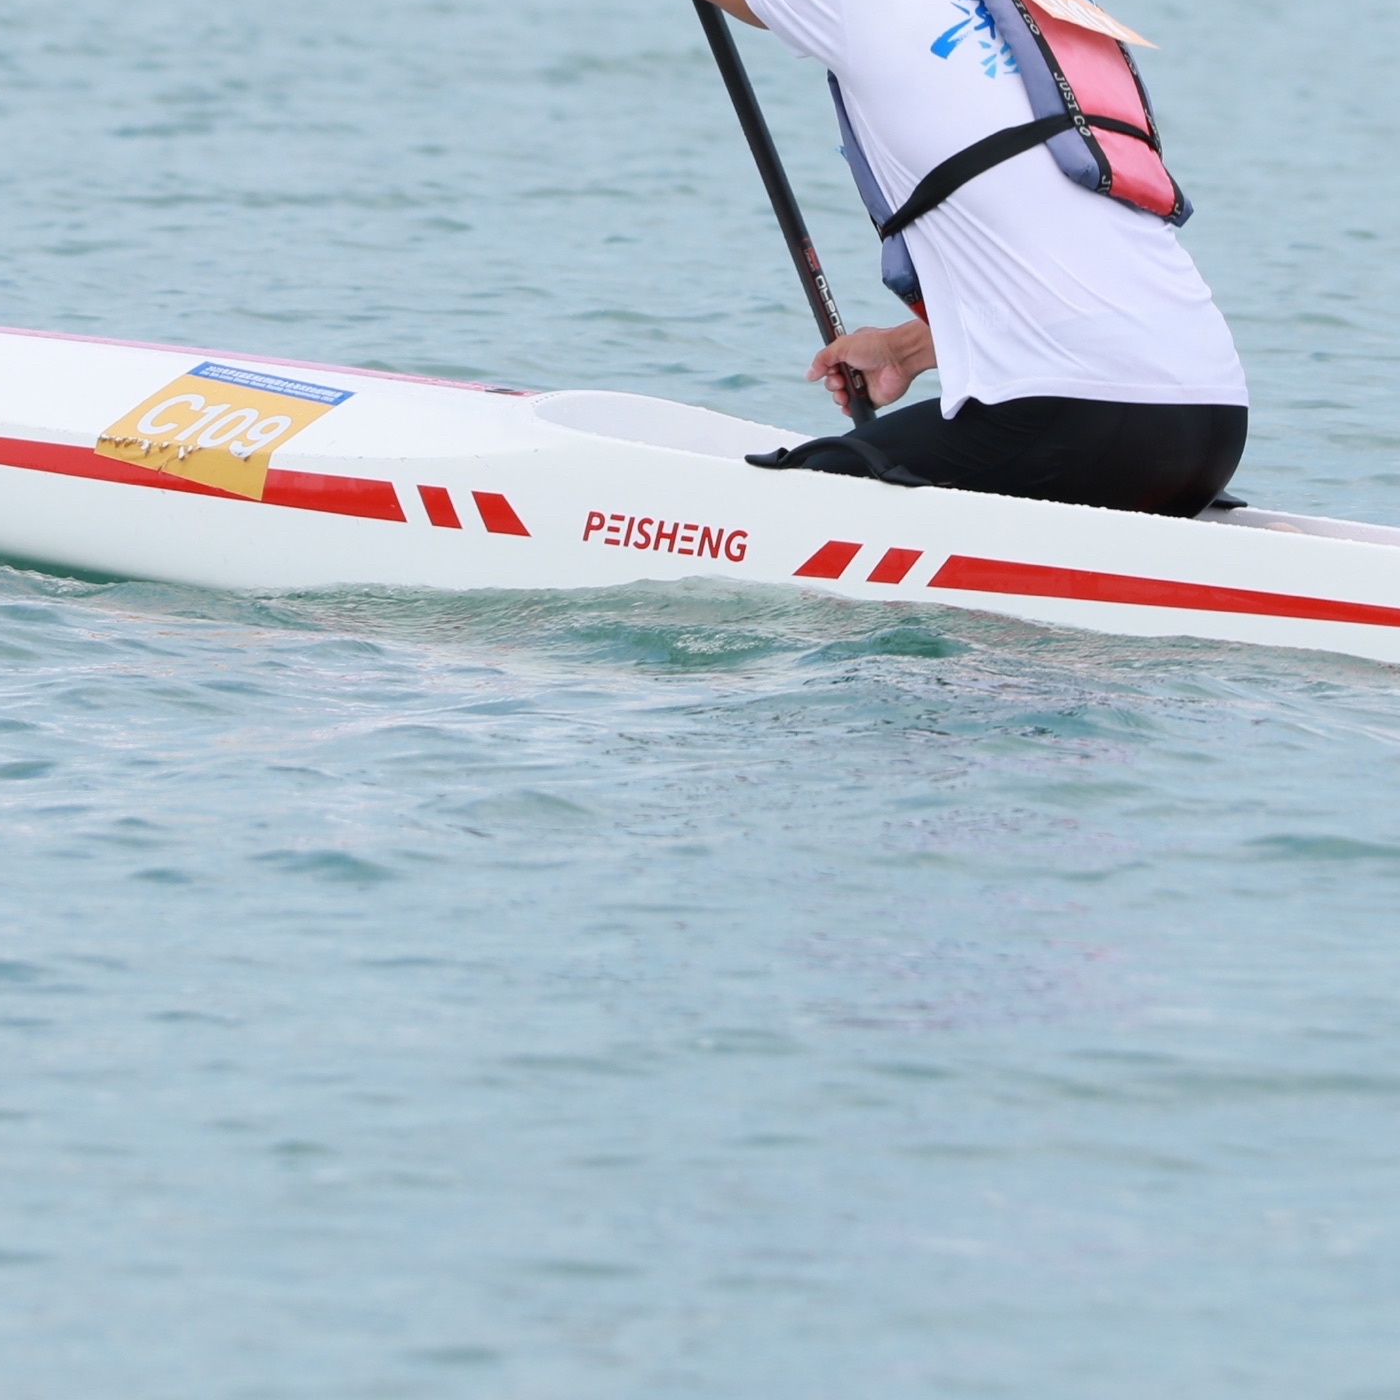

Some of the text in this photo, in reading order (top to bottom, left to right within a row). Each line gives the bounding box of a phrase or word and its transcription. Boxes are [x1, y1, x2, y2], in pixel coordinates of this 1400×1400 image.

[1023, 13, 1041, 36] GO
[1053, 71, 1091, 138] JUST GO
[136, 393, 292, 458] C109
[582, 510, 748, 563] PEISHENG
